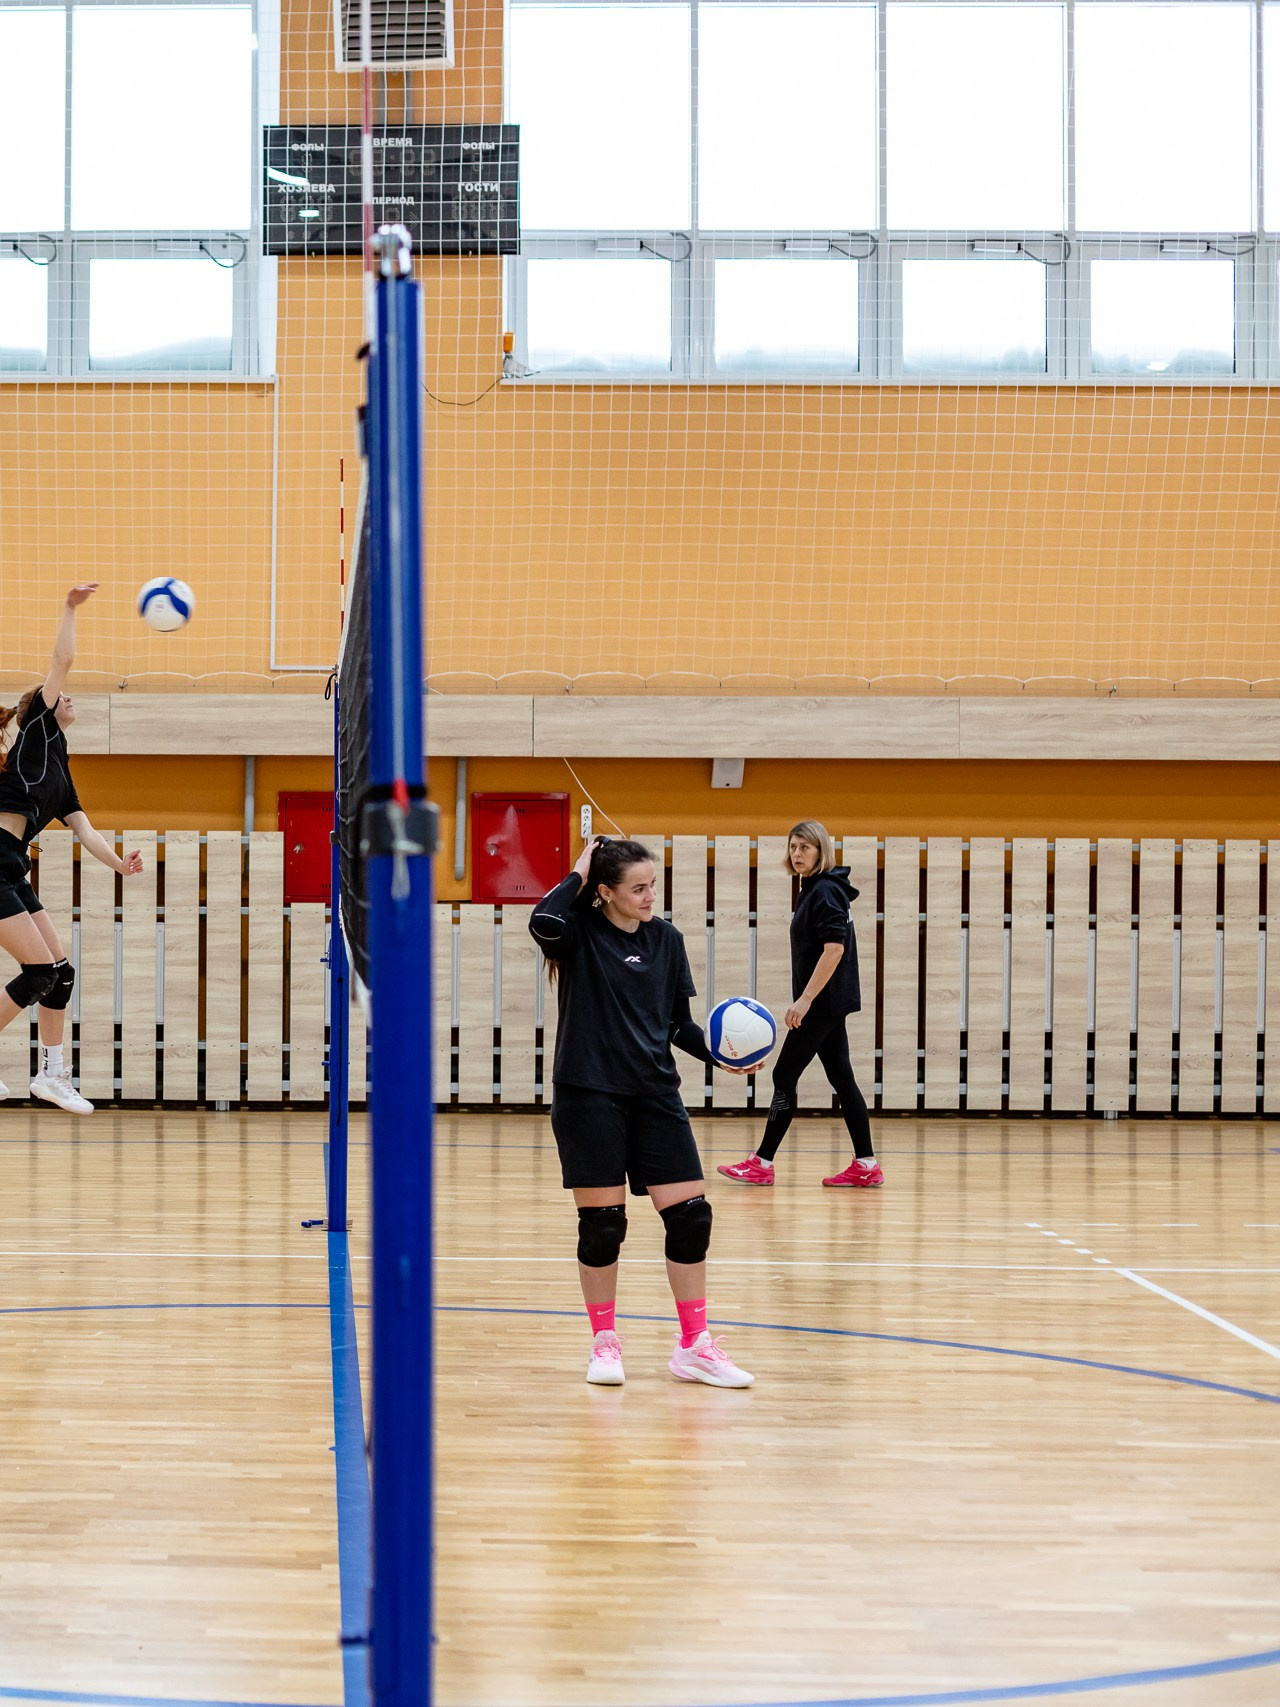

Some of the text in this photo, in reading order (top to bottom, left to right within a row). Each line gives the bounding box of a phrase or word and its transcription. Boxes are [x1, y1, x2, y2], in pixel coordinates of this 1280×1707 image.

[372, 138, 413, 147] ВРЕМЯ
[277, 184, 336, 193] ХОЗЯЕВА
[458, 182, 500, 192] ГОСТИ
[372, 196, 415, 206] ПЕРИОД
